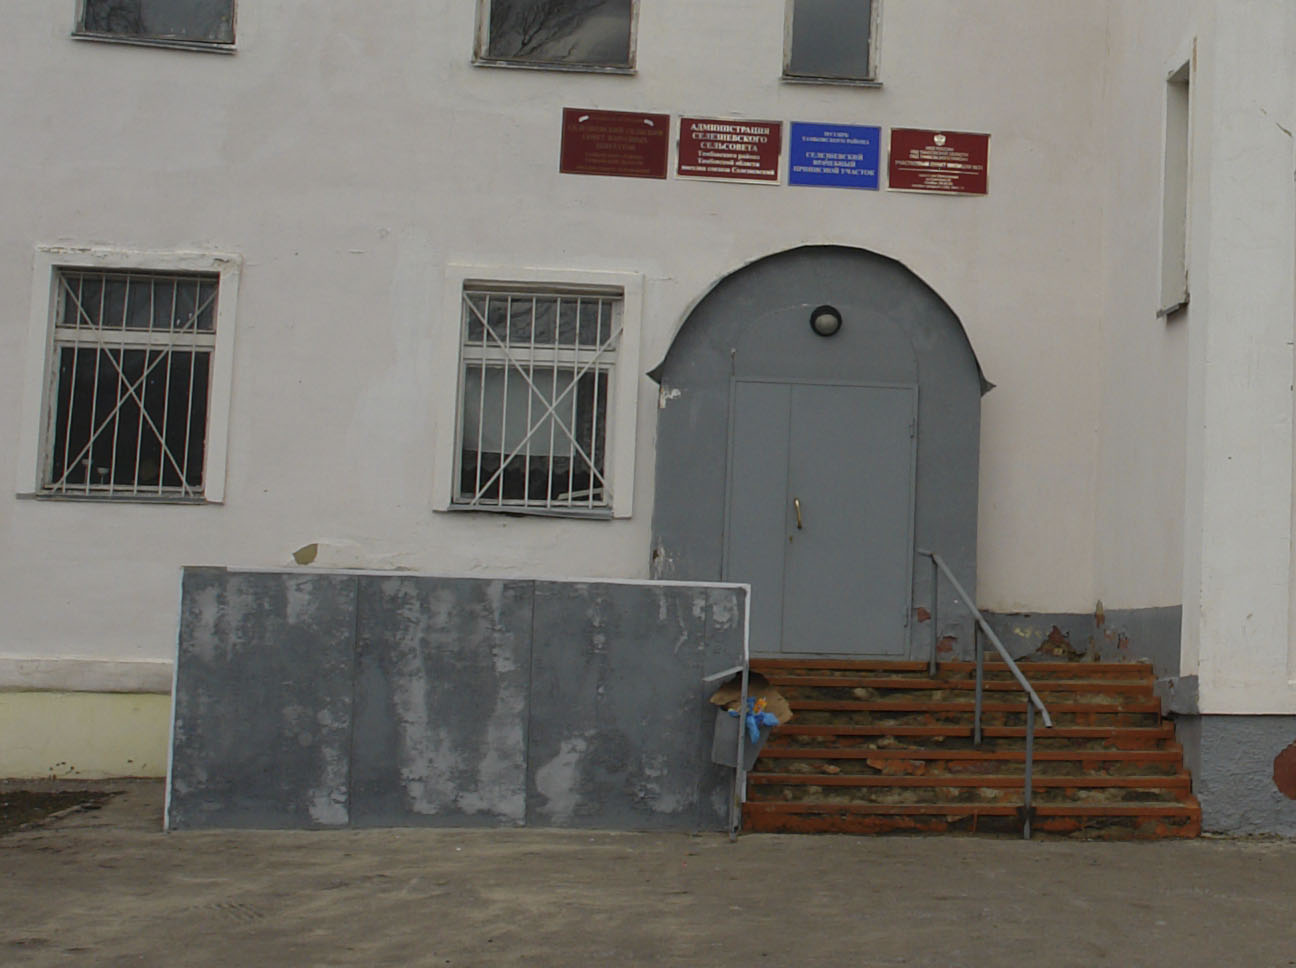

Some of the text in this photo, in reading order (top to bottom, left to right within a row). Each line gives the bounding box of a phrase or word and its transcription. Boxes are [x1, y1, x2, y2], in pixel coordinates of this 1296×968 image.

[690, 123, 770, 135] АДМИНИСТРАЦИЯ
[691, 132, 768, 143] СЕЛЕЗНЕВСКОГО
[700, 141, 758, 152] СЕЛЬСОВЕТА
